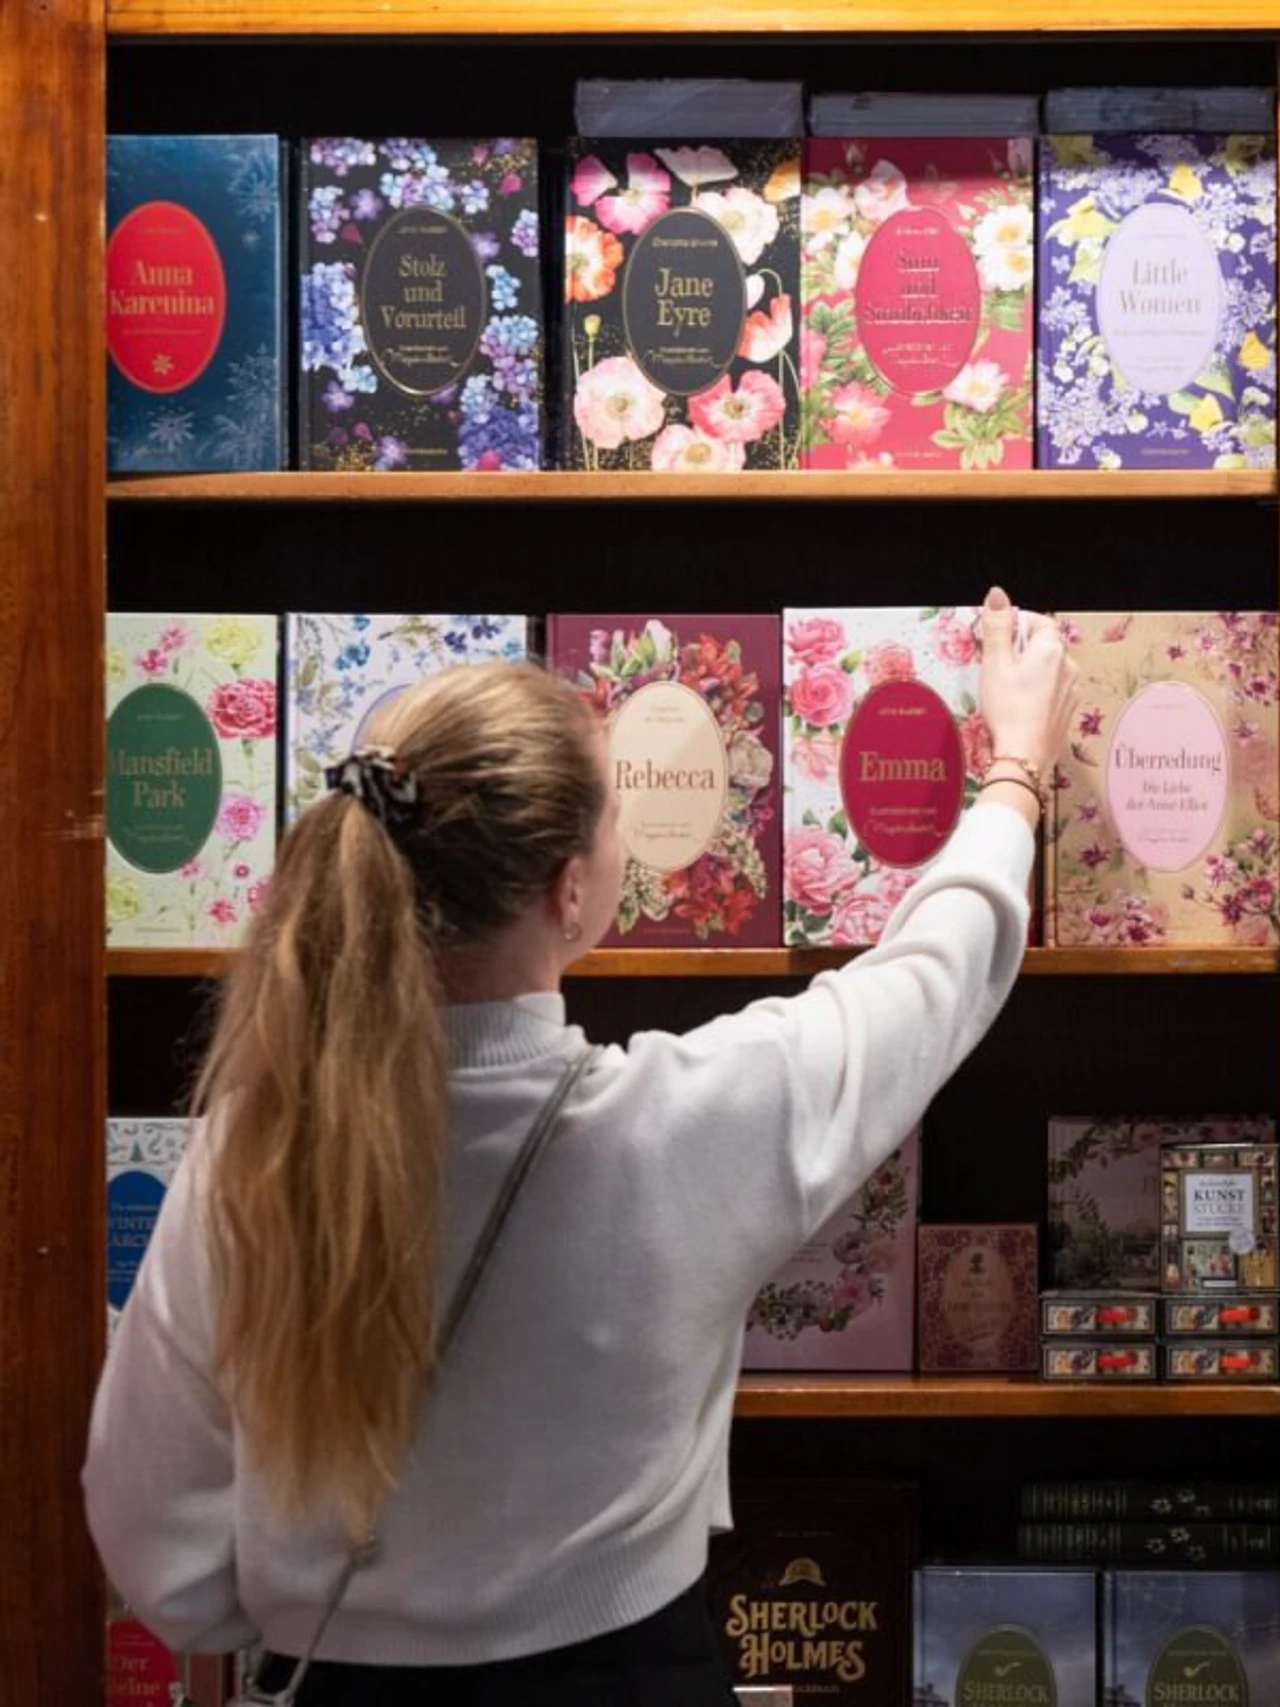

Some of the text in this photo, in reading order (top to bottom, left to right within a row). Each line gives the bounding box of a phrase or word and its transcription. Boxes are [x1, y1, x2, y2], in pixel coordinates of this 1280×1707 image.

[130, 259, 193, 286] Anna
[399, 253, 446, 277] Stolz
[1132, 257, 1188, 286] Little
[404, 280, 443, 303] und
[654, 267, 714, 298] Jane
[110, 289, 214, 315] Karenina
[1119, 290, 1201, 314] Women
[381, 305, 467, 329] Vorurteil
[656, 299, 711, 338] Eyre
[858, 750, 947, 783] Emma
[1115, 742, 1223, 776] Überredung
[615, 757, 715, 790] Rebecca
[133, 780, 187, 809] Park
[1194, 1189, 1246, 1201] KUNST
[725, 1594, 879, 1638] SHERLOCK
[739, 1632, 866, 1683] HOLMES
[963, 1680, 1049, 1702] SHERLOCK
[1154, 1680, 1239, 1702] SHERLOCK
